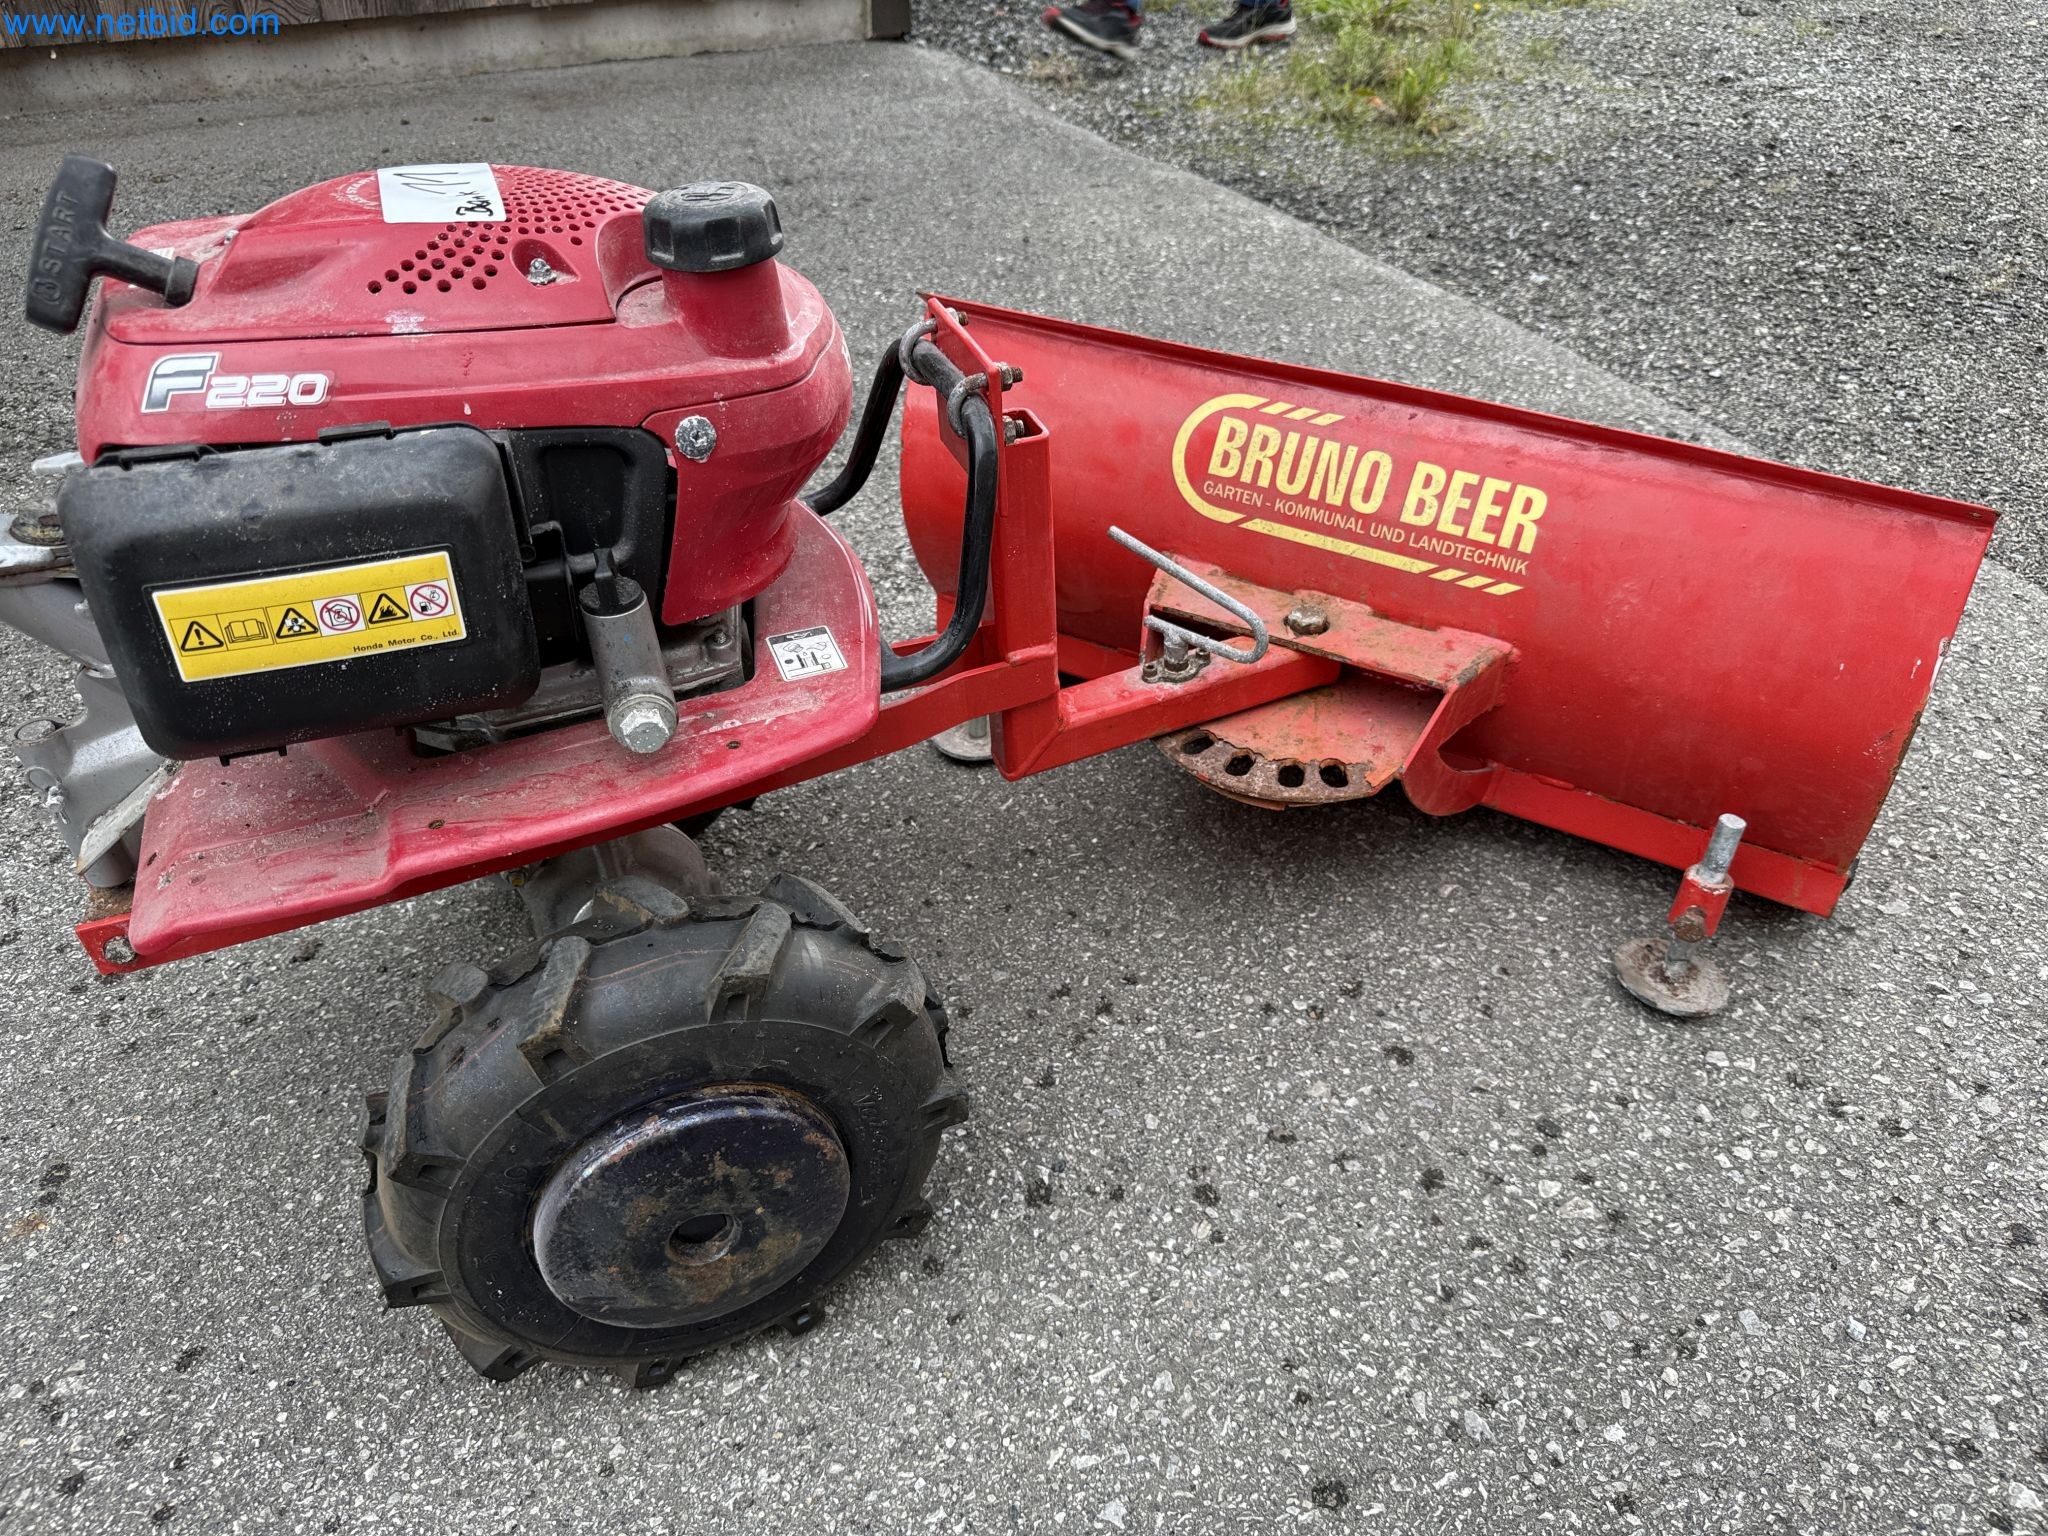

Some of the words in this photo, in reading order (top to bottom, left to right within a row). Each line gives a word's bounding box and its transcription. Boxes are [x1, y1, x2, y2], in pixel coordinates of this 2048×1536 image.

[38, 190, 80, 274] START
[140, 351, 329, 413] F220
[1208, 416, 1392, 514] BRUNO
[1400, 461, 1548, 554] BEER
[1203, 480, 1264, 507] GARTEN
[1274, 498, 1366, 534] KOMMUNAL
[1369, 522, 1406, 544] UND
[1408, 532, 1530, 576] LANDTECHNIK
[353, 643, 383, 652] Honda
[388, 637, 415, 647] Motor
[442, 629, 460, 638] Ltd.
